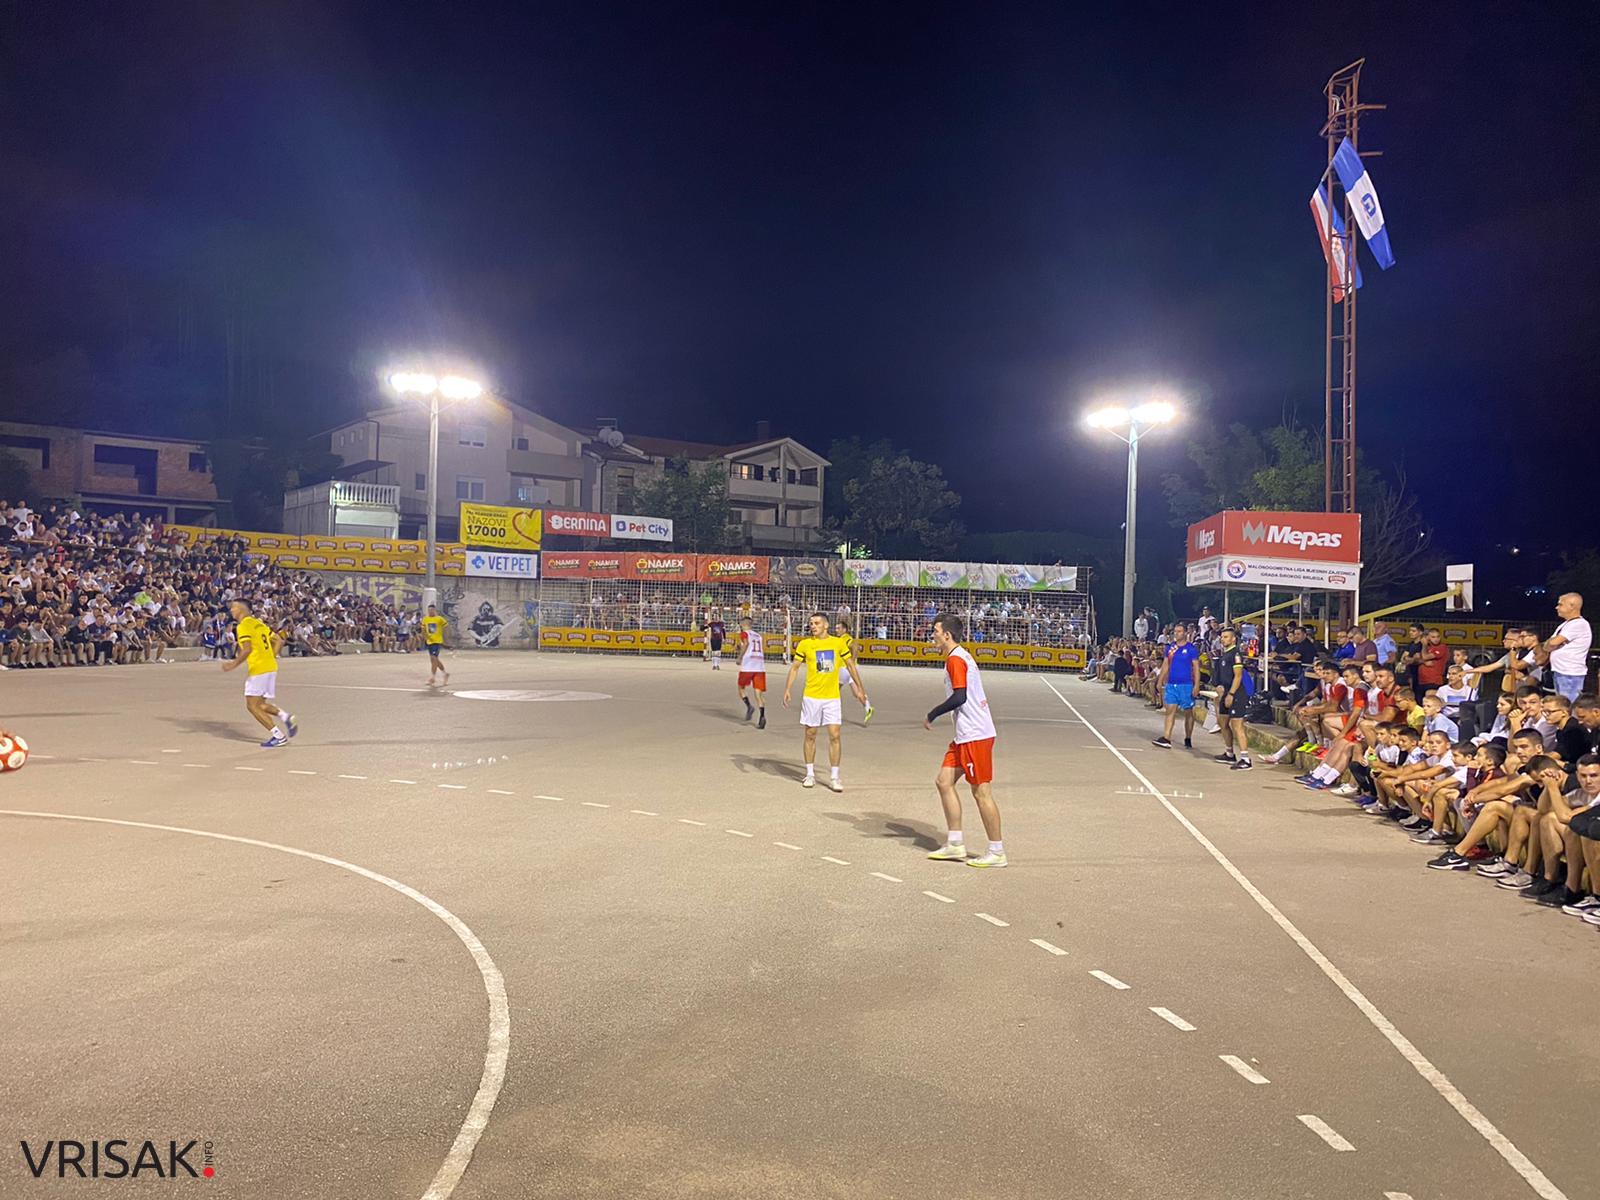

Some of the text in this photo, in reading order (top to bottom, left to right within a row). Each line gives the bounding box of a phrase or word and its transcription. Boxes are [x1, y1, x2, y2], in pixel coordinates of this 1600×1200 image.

[466, 515, 506, 528] NAZOVI
[549, 514, 606, 532] BERNINA
[466, 525, 506, 538] 17000
[629, 523, 669, 537] Pet City
[1199, 529, 1215, 554] Mepas
[1267, 525, 1342, 551] Mepas
[488, 555, 532, 572] VET PET
[555, 559, 580, 567] NAMEX
[595, 559, 619, 567] NAMEX
[648, 558, 684, 569] NAMEX
[720, 560, 756, 571] NAMEX
[752, 640, 761, 653] 11
[966, 762, 974, 777] 7
